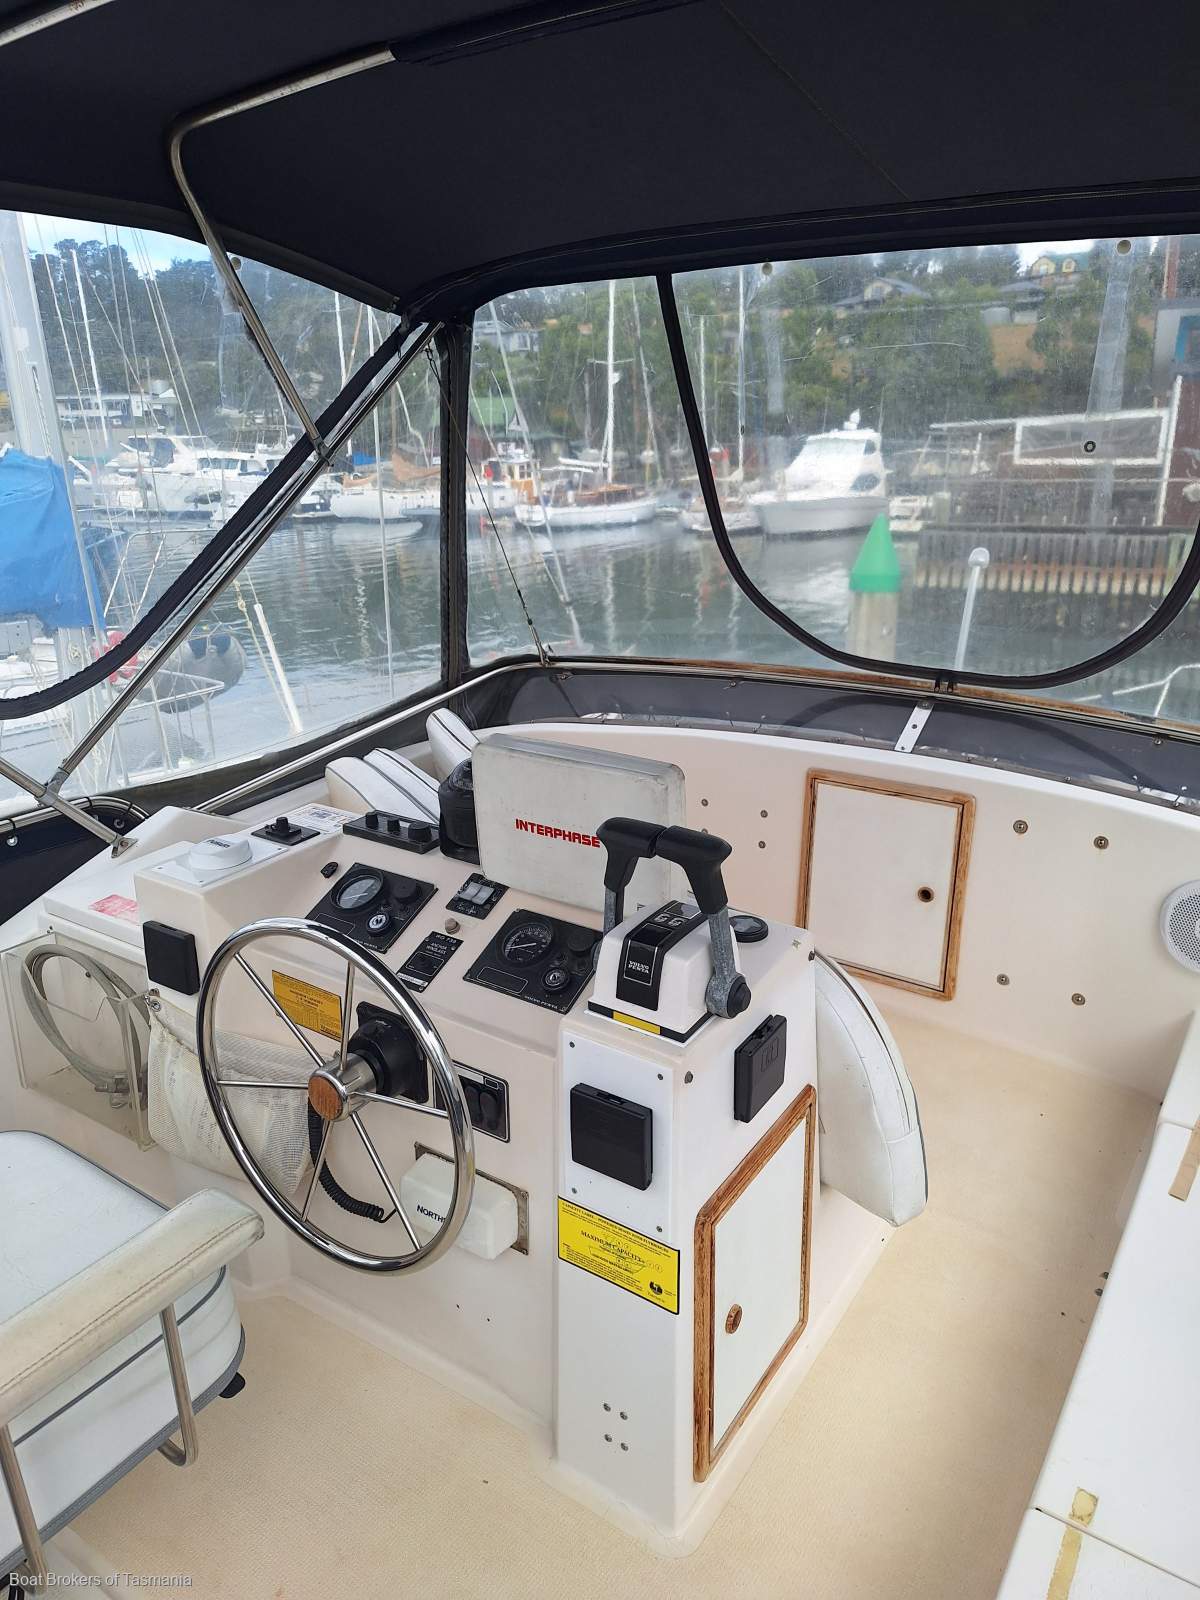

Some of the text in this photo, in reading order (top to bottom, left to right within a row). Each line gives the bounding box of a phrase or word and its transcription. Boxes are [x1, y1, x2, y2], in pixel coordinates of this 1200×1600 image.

[515, 818, 601, 848] INTERPHASE
[628, 963, 649, 974] PENTA
[629, 960, 649, 970] VOLVO
